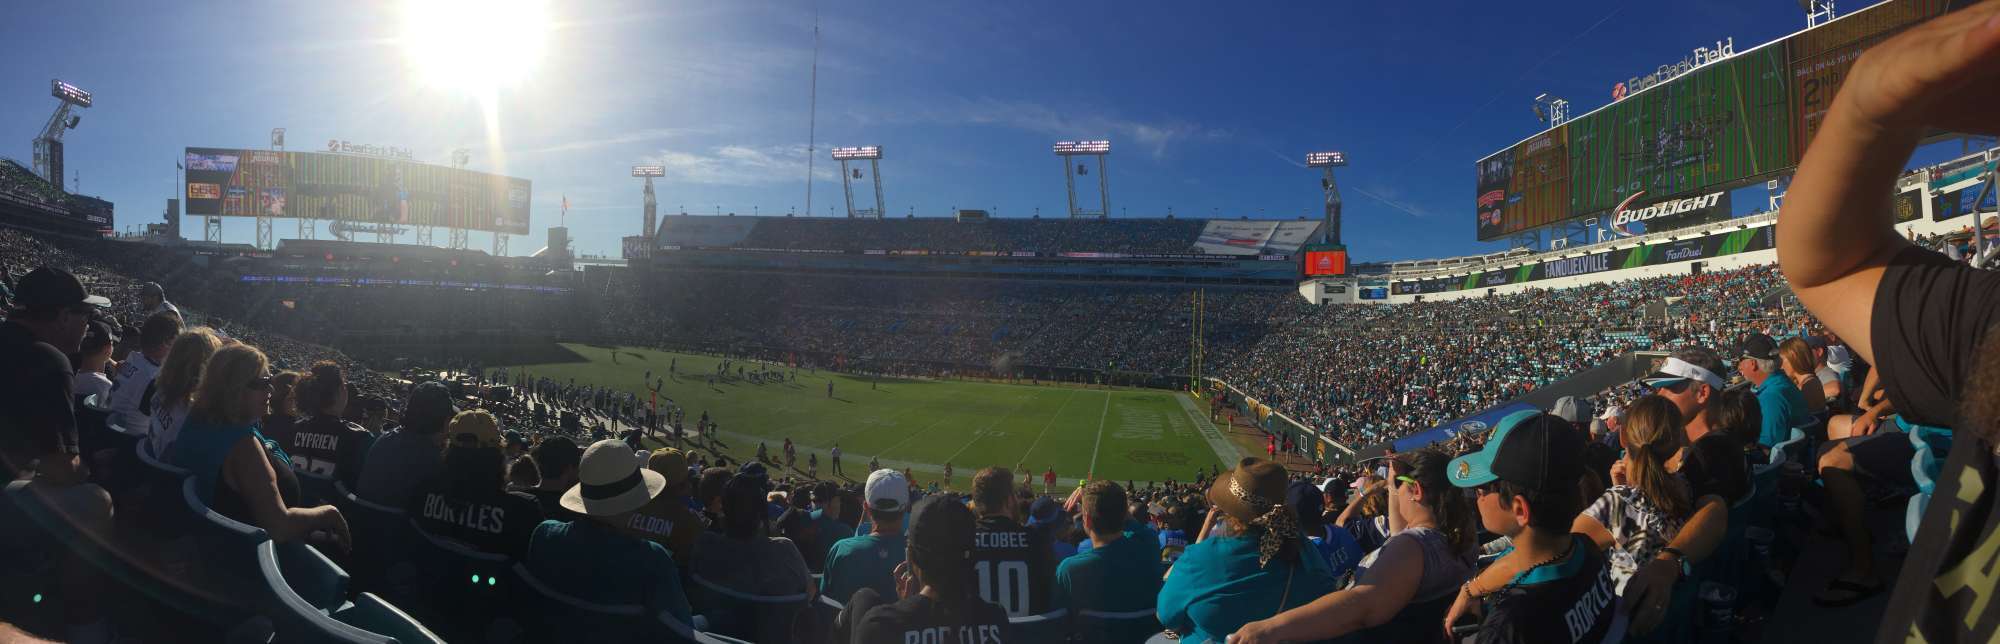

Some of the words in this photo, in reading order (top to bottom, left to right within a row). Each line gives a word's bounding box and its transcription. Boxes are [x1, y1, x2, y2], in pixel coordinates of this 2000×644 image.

[1629, 56, 1694, 93] EverBank
[1694, 37, 1735, 67] Field
[1615, 206, 1659, 226] BUD
[1657, 191, 1724, 217] LIGHT
[1544, 252, 1609, 278] FANDUELVILLE
[1665, 246, 1702, 263] FanDuel
[294, 431, 338, 451] CYPRIEN
[975, 560, 1029, 618] 10
